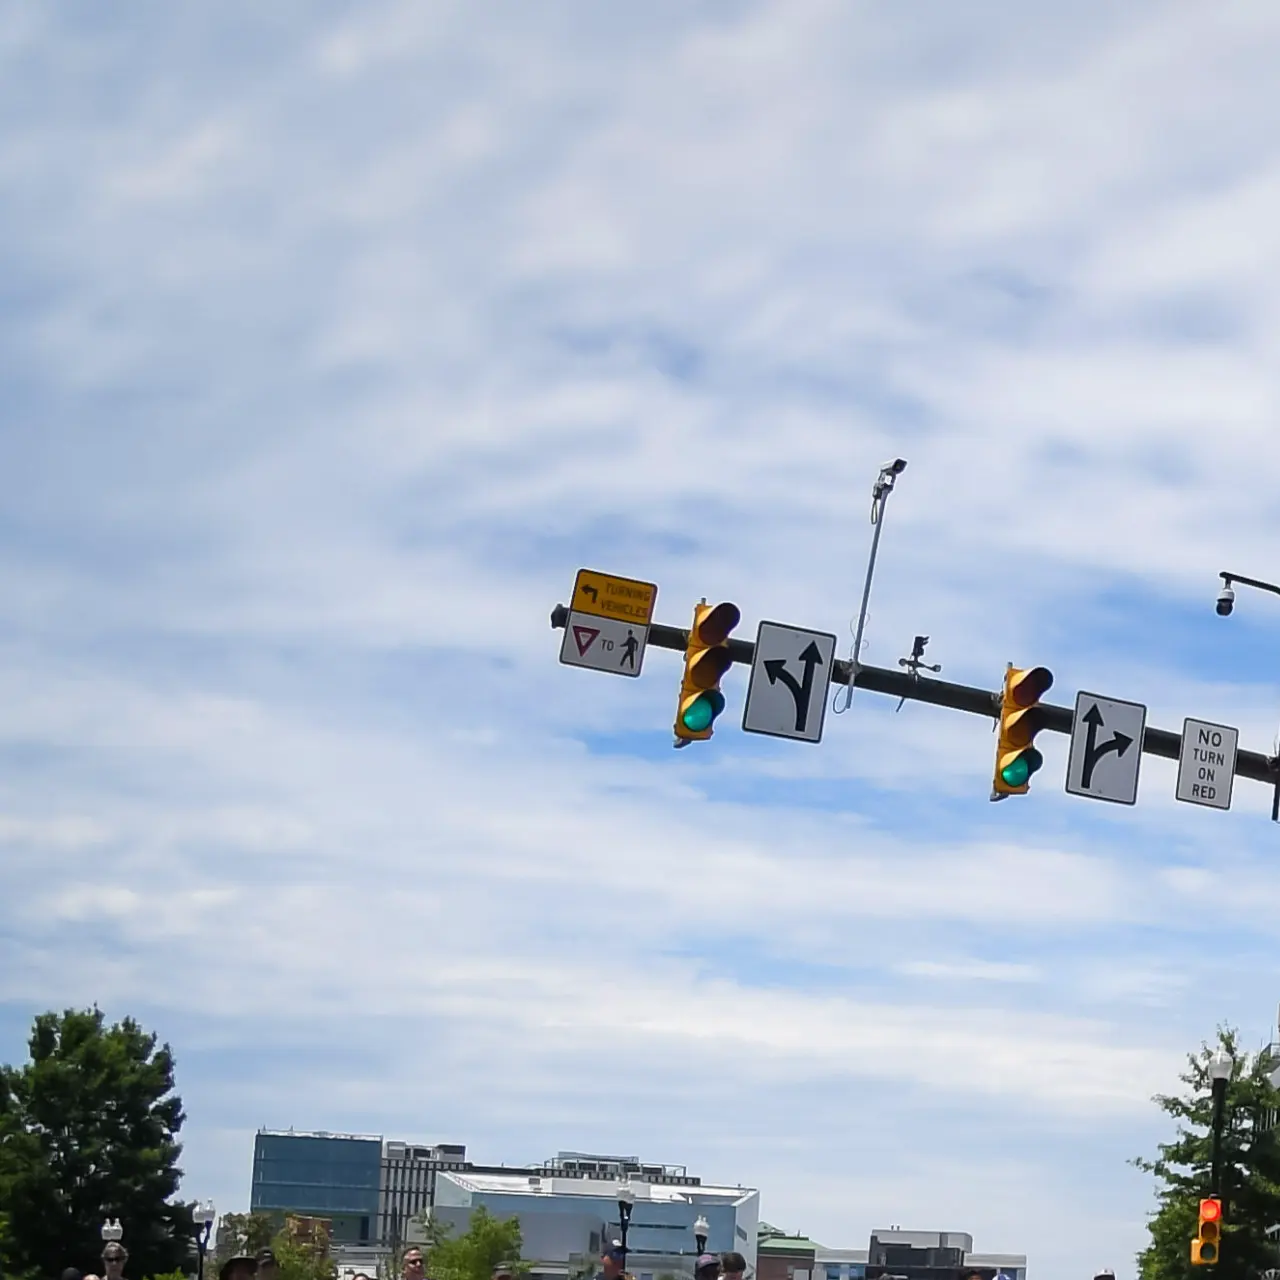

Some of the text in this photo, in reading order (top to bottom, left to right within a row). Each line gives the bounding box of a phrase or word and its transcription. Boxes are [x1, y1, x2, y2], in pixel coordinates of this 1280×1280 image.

[606, 582, 651, 601] TURNING
[601, 639, 614, 651] TO
[1199, 729, 1222, 747] NO
[1193, 748, 1225, 766] TURN
[1198, 767, 1215, 782] ON
[1192, 783, 1217, 799] RED
